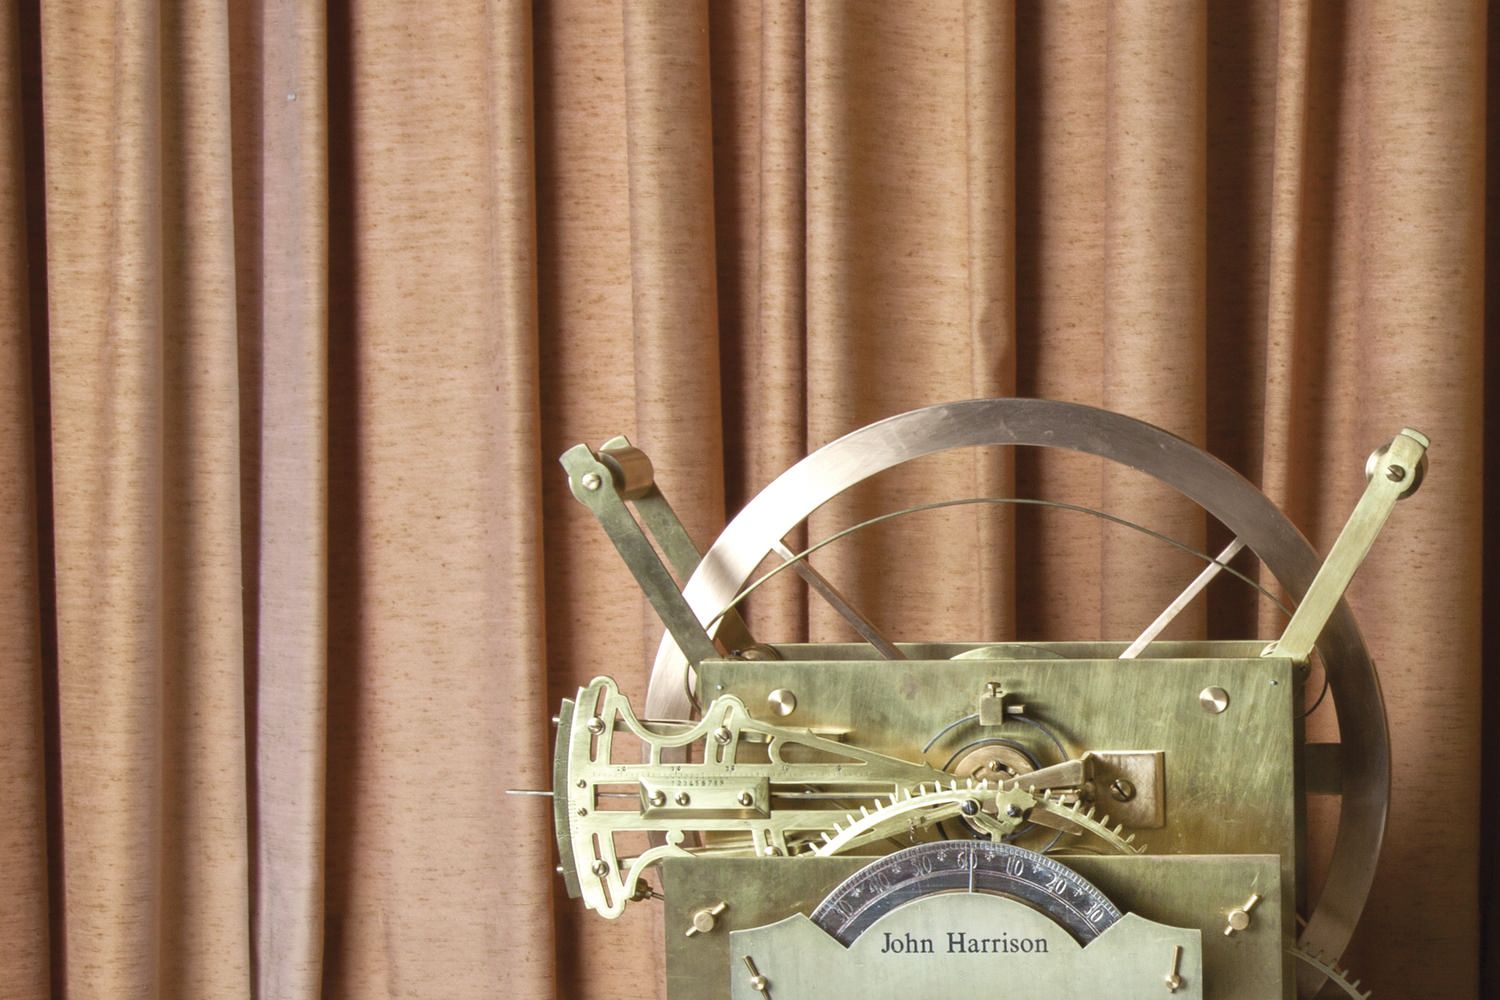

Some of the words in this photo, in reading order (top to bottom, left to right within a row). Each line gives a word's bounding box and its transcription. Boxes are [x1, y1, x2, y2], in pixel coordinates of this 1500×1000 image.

[1006, 854, 1024, 877] 10
[1045, 873, 1067, 895] 20
[1083, 900, 1104, 923] 30
[881, 932, 935, 954] John
[946, 932, 1049, 954] Harrison
